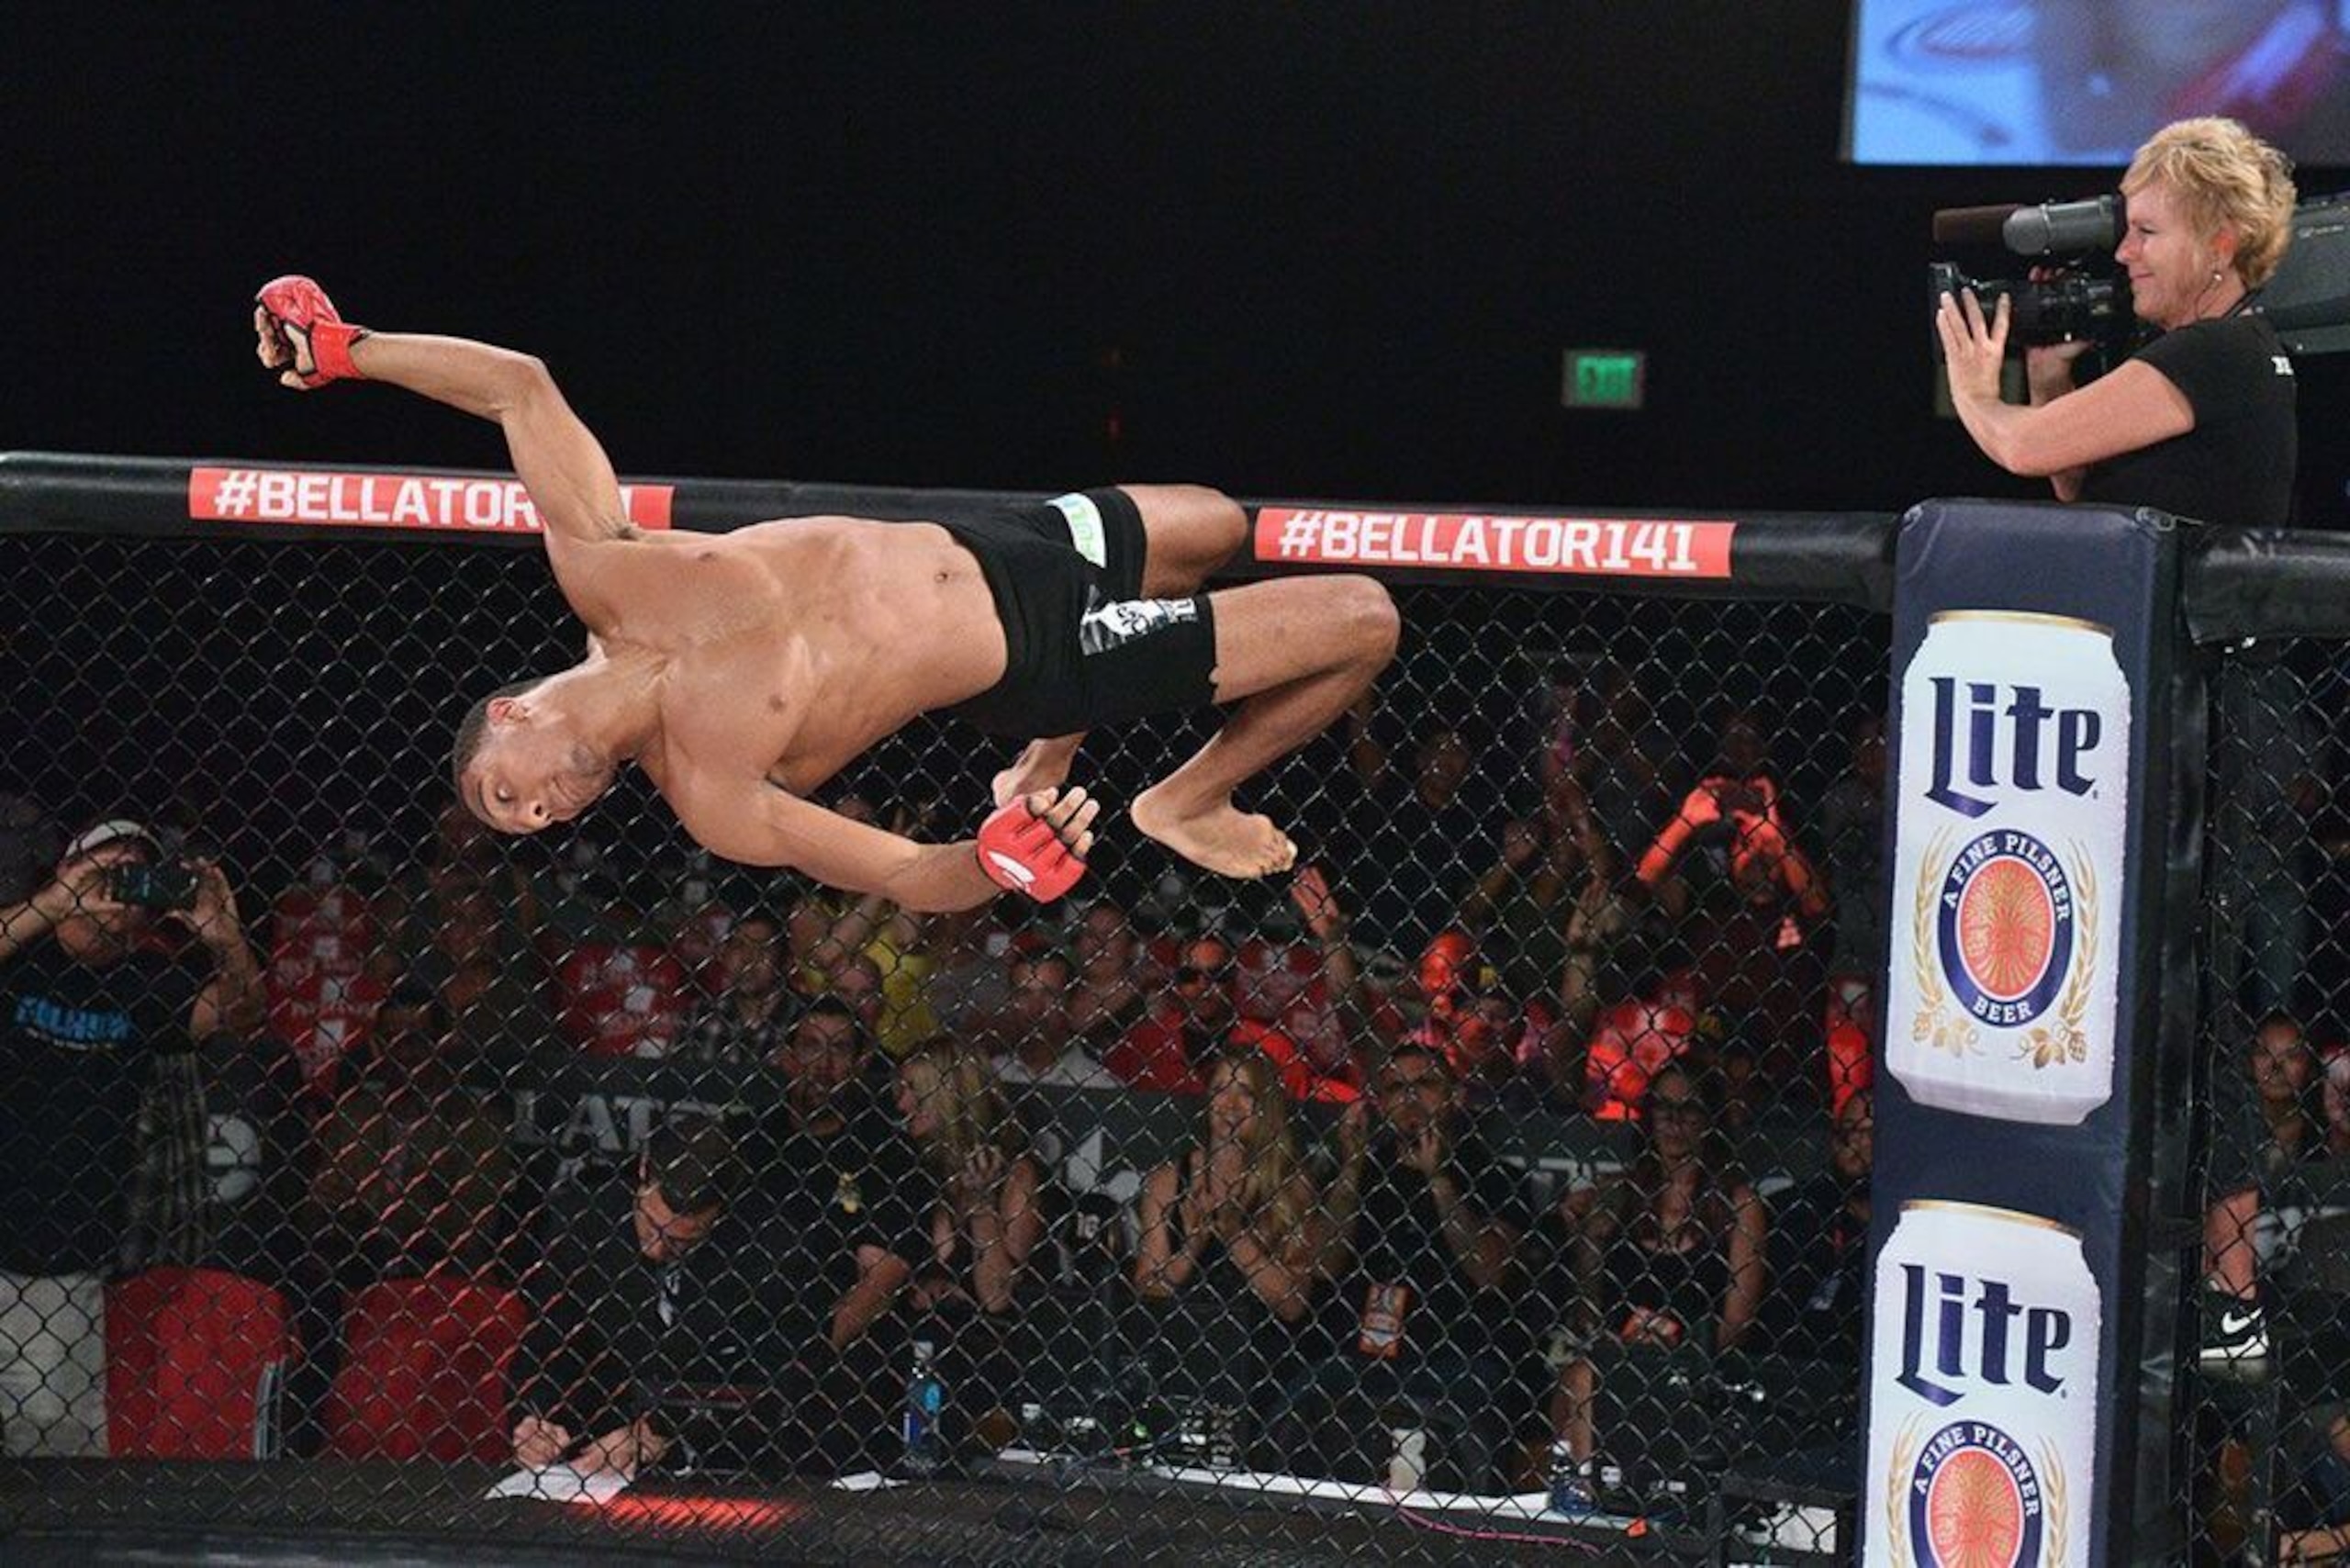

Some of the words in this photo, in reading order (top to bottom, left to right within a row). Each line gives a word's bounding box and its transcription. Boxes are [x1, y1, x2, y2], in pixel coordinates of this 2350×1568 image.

[214, 471, 634, 530] #BELLATOR
[1279, 510, 1698, 571] #BELLATOR141
[1923, 677, 2101, 819] Lite
[1943, 891, 1959, 909] A
[1951, 835, 1998, 885] FINE
[2005, 834, 2072, 923] PILSNER
[1974, 994, 2033, 1024] BEER
[1895, 1263, 2071, 1407] Lite
[1914, 1477, 1929, 1495] A
[1923, 1426, 1966, 1470] FINE
[1974, 1425, 2040, 1517] PILSNER
